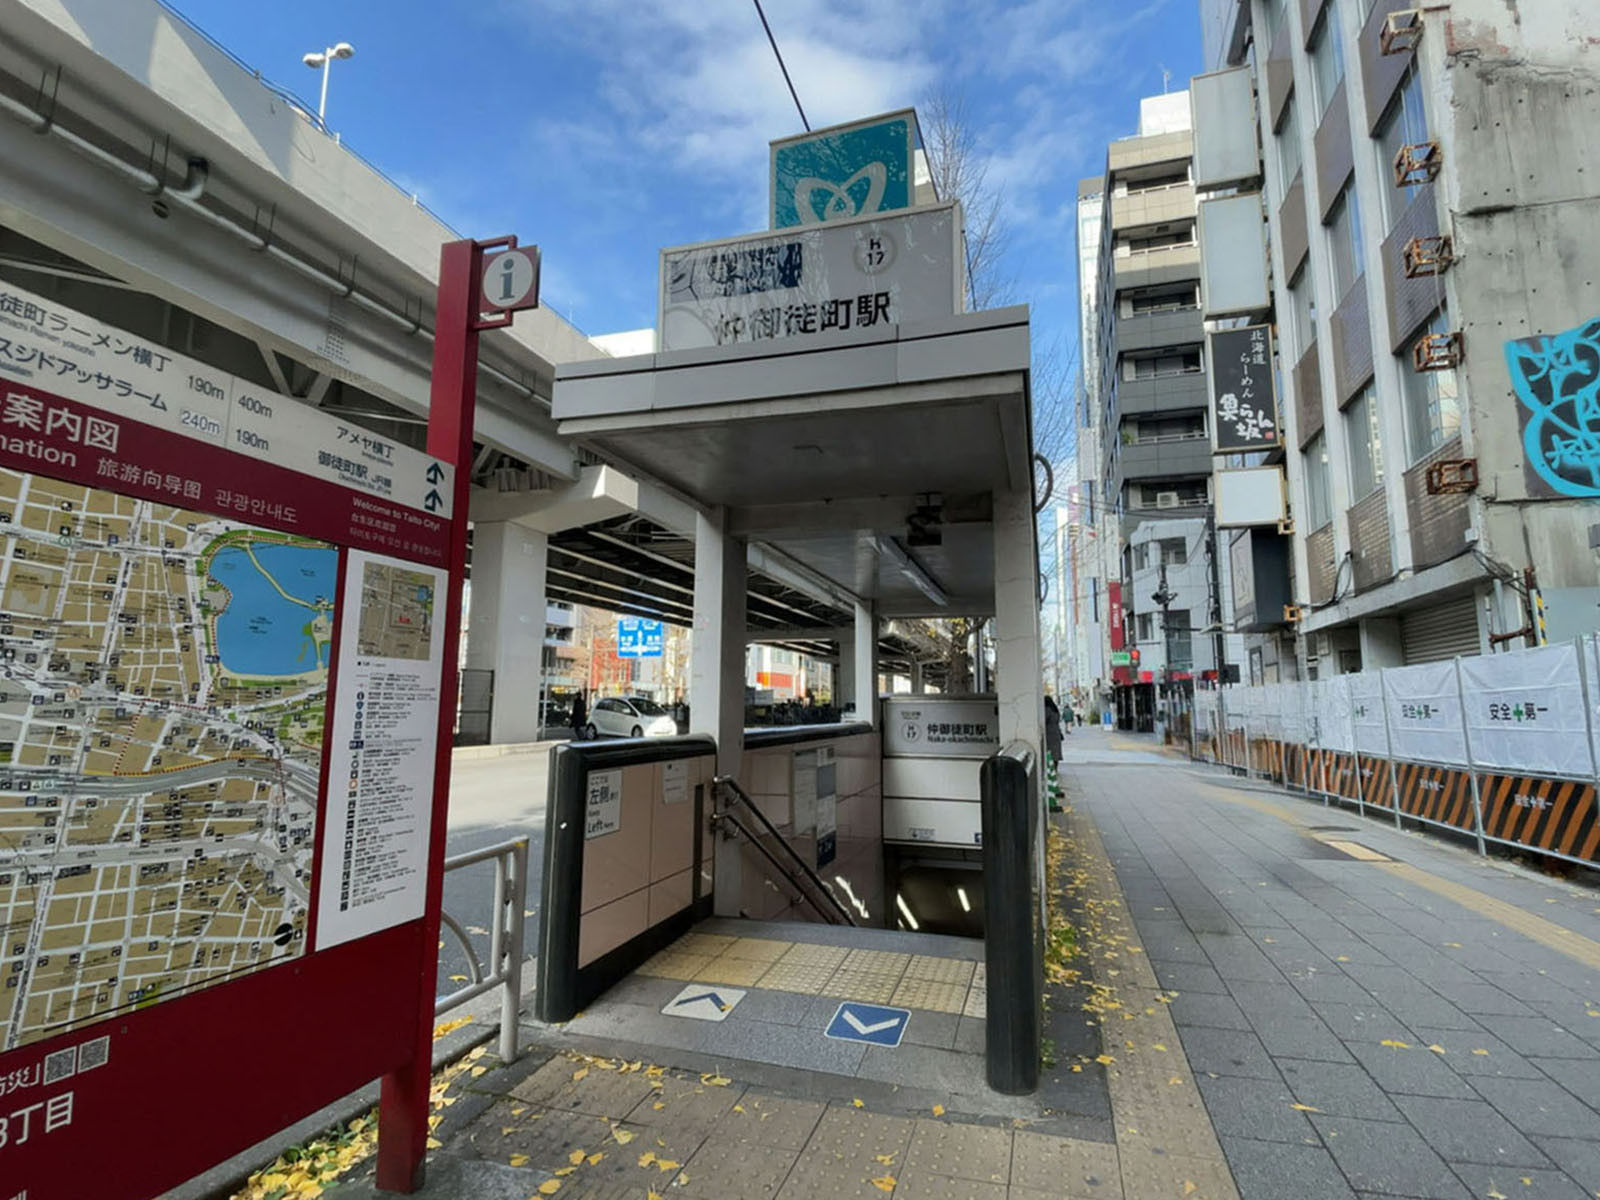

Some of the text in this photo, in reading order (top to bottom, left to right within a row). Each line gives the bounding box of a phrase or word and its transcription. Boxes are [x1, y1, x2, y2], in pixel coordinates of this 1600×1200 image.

[867, 250, 885, 266] 17
[1250, 330, 1266, 365] 北海道
[188, 375, 224, 400] 190m
[1240, 353, 1254, 398] らーめん
[238, 394, 273, 419] 400m
[2, 392, 120, 454] 案内図
[181, 410, 220, 435] 240m
[235, 428, 270, 451] 190m
[337, 426, 396, 459] アメヤ横丁
[97, 457, 202, 500] 旅游向导图
[215, 488, 298, 524] 관광안내도
[352, 496, 391, 517] Welcome
[392, 509, 402, 520] to
[403, 511, 422, 526] Taito
[927, 722, 987, 736] 仲御徒町駅
